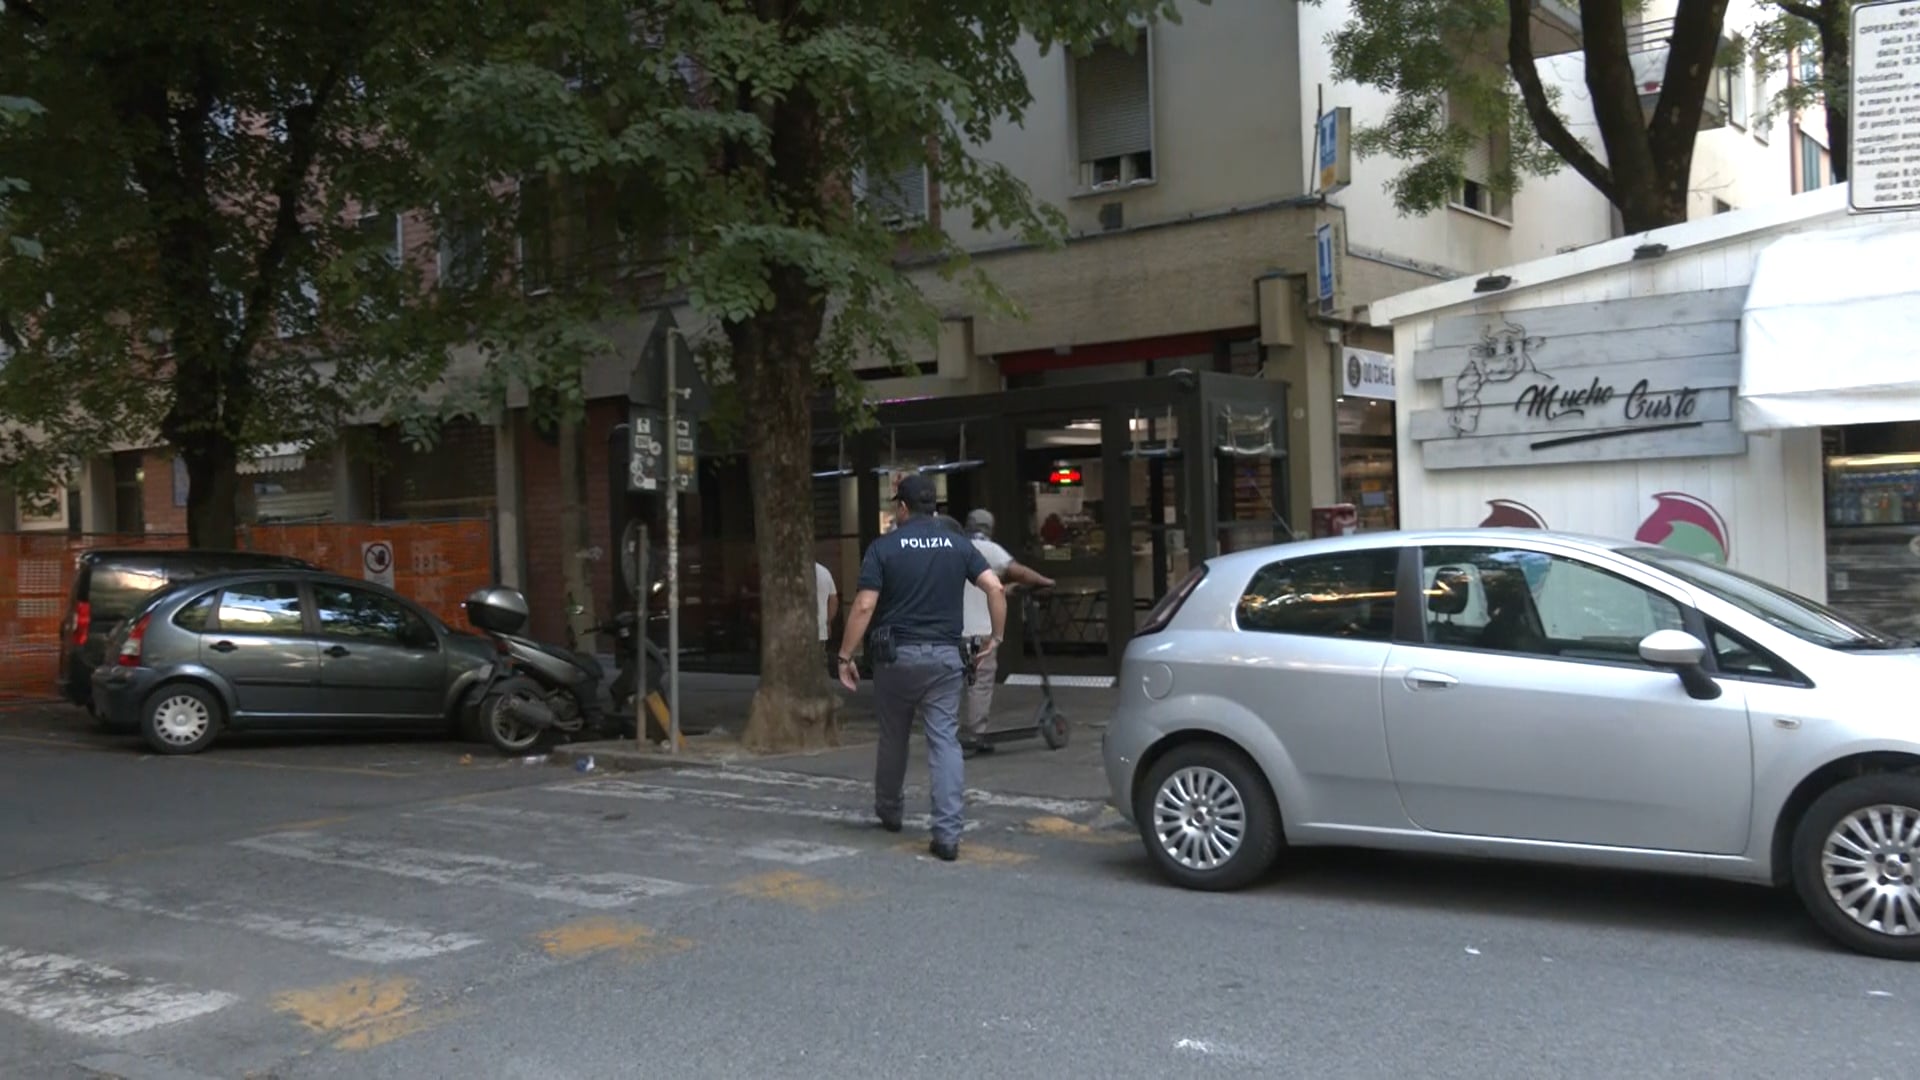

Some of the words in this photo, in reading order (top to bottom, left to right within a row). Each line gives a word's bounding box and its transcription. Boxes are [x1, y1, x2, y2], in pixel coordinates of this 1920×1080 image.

[1860, 20, 1919, 34] OPERATORI
[1515, 376, 1615, 421] Mucho
[1624, 378, 1701, 420] Gusto
[900, 536, 953, 549] POLIZIA
